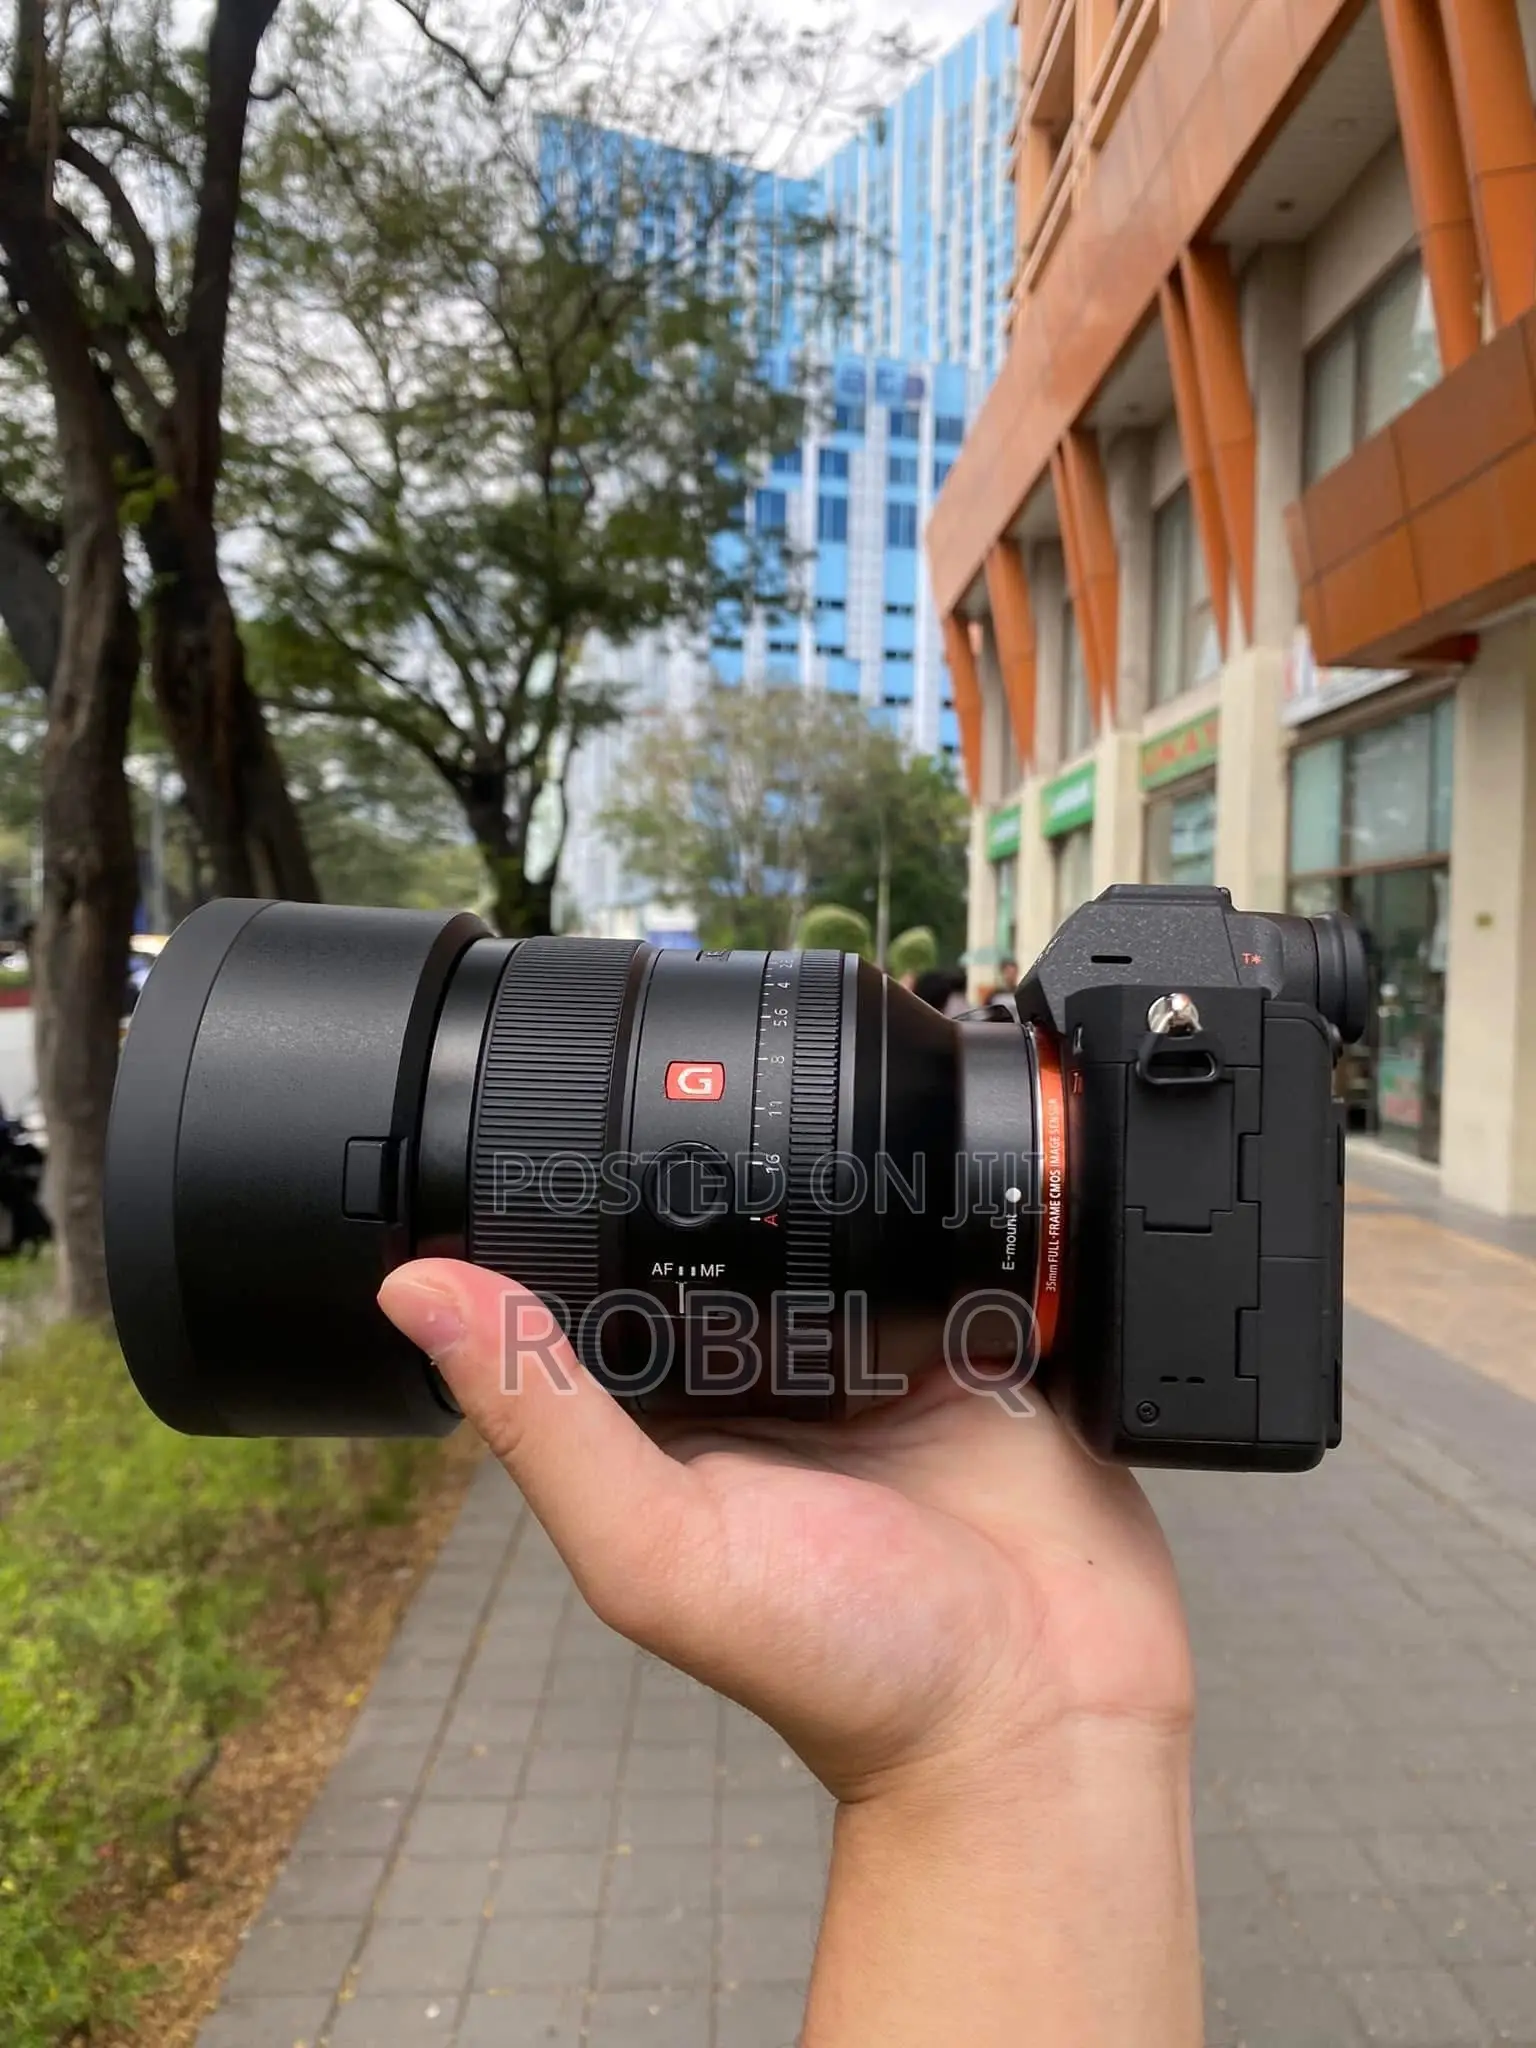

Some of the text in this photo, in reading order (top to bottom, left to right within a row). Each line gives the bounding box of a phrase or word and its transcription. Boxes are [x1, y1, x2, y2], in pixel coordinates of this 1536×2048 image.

[773, 1008, 789, 1027] 5.6
[770, 1055, 785, 1064] 8
[677, 1067, 713, 1096] G
[768, 1101, 783, 1117] 11
[1048, 1136, 1061, 1168] IMAGE
[765, 1154, 781, 1174] 16
[1048, 1170, 1062, 1199] CMOS
[763, 1214, 778, 1227] A
[1002, 1213, 1018, 1270] E-mount
[651, 1262, 674, 1276] AF
[700, 1263, 726, 1278] MF
[1045, 1264, 1058, 1292] 35mm
